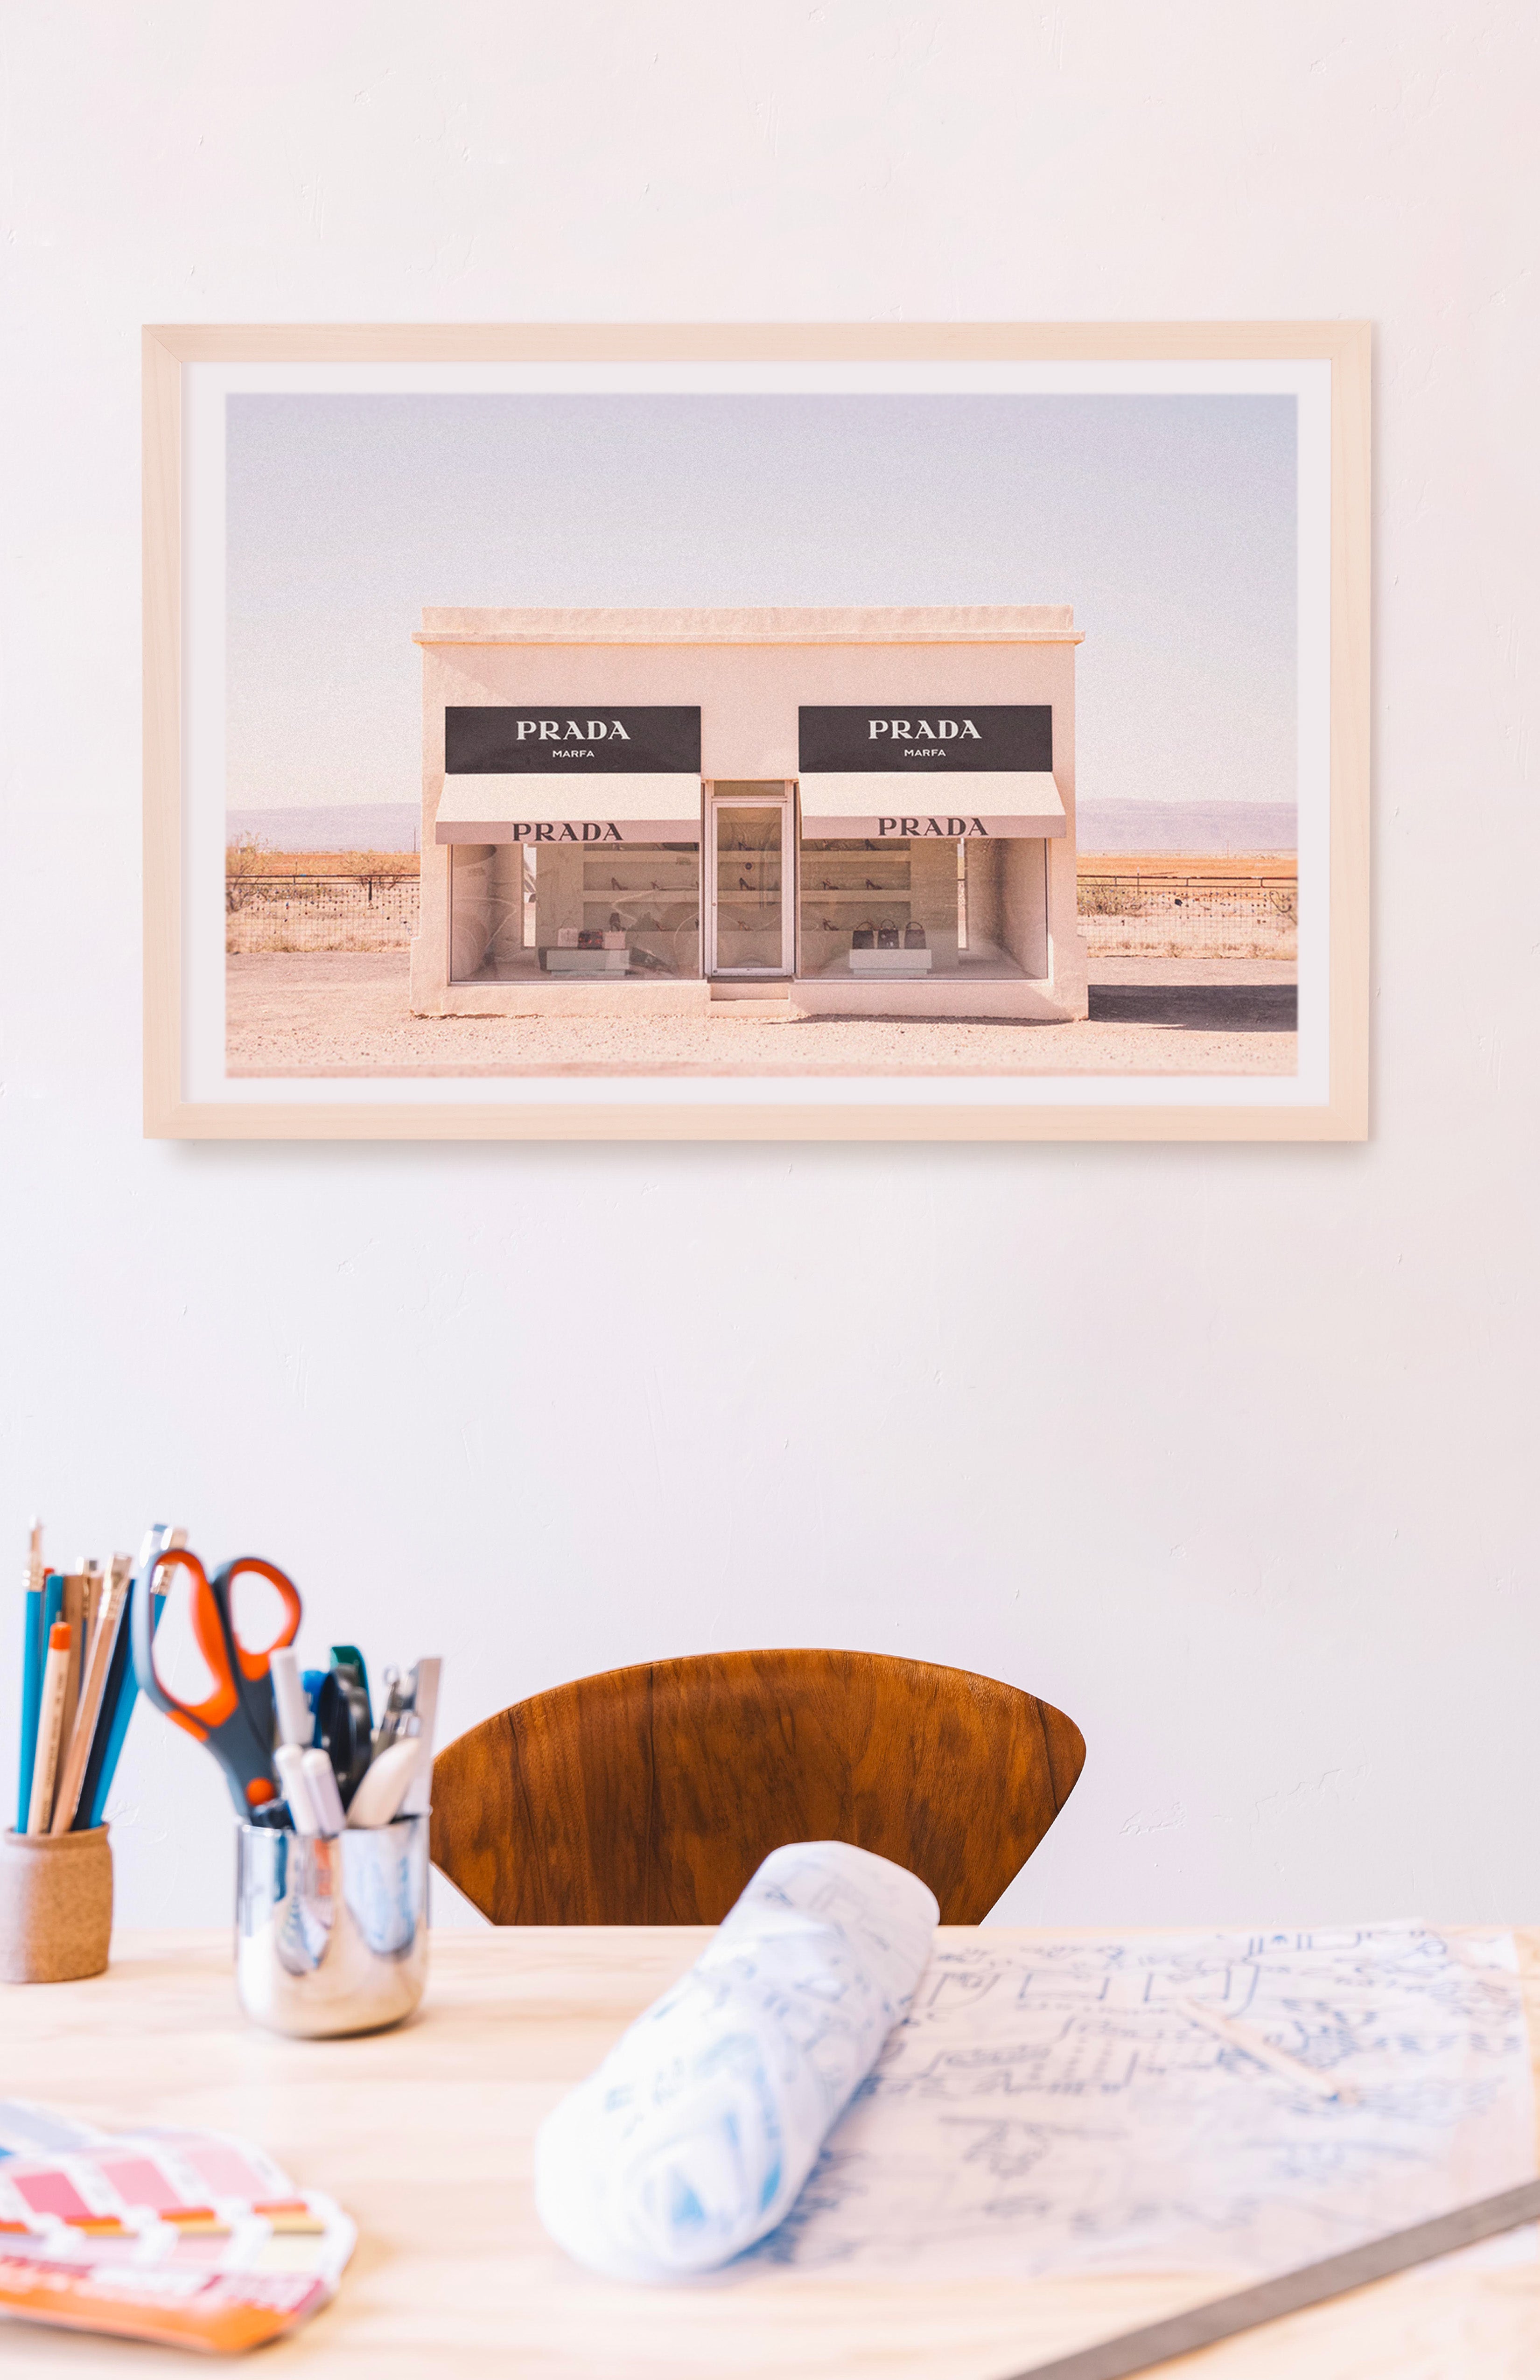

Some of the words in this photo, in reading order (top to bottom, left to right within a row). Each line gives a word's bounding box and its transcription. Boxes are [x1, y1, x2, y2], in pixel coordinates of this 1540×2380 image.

[516, 721, 631, 741] PRADA
[868, 720, 982, 740] PRADA
[512, 823, 624, 841] PRADA
[878, 818, 989, 836] PRADA
